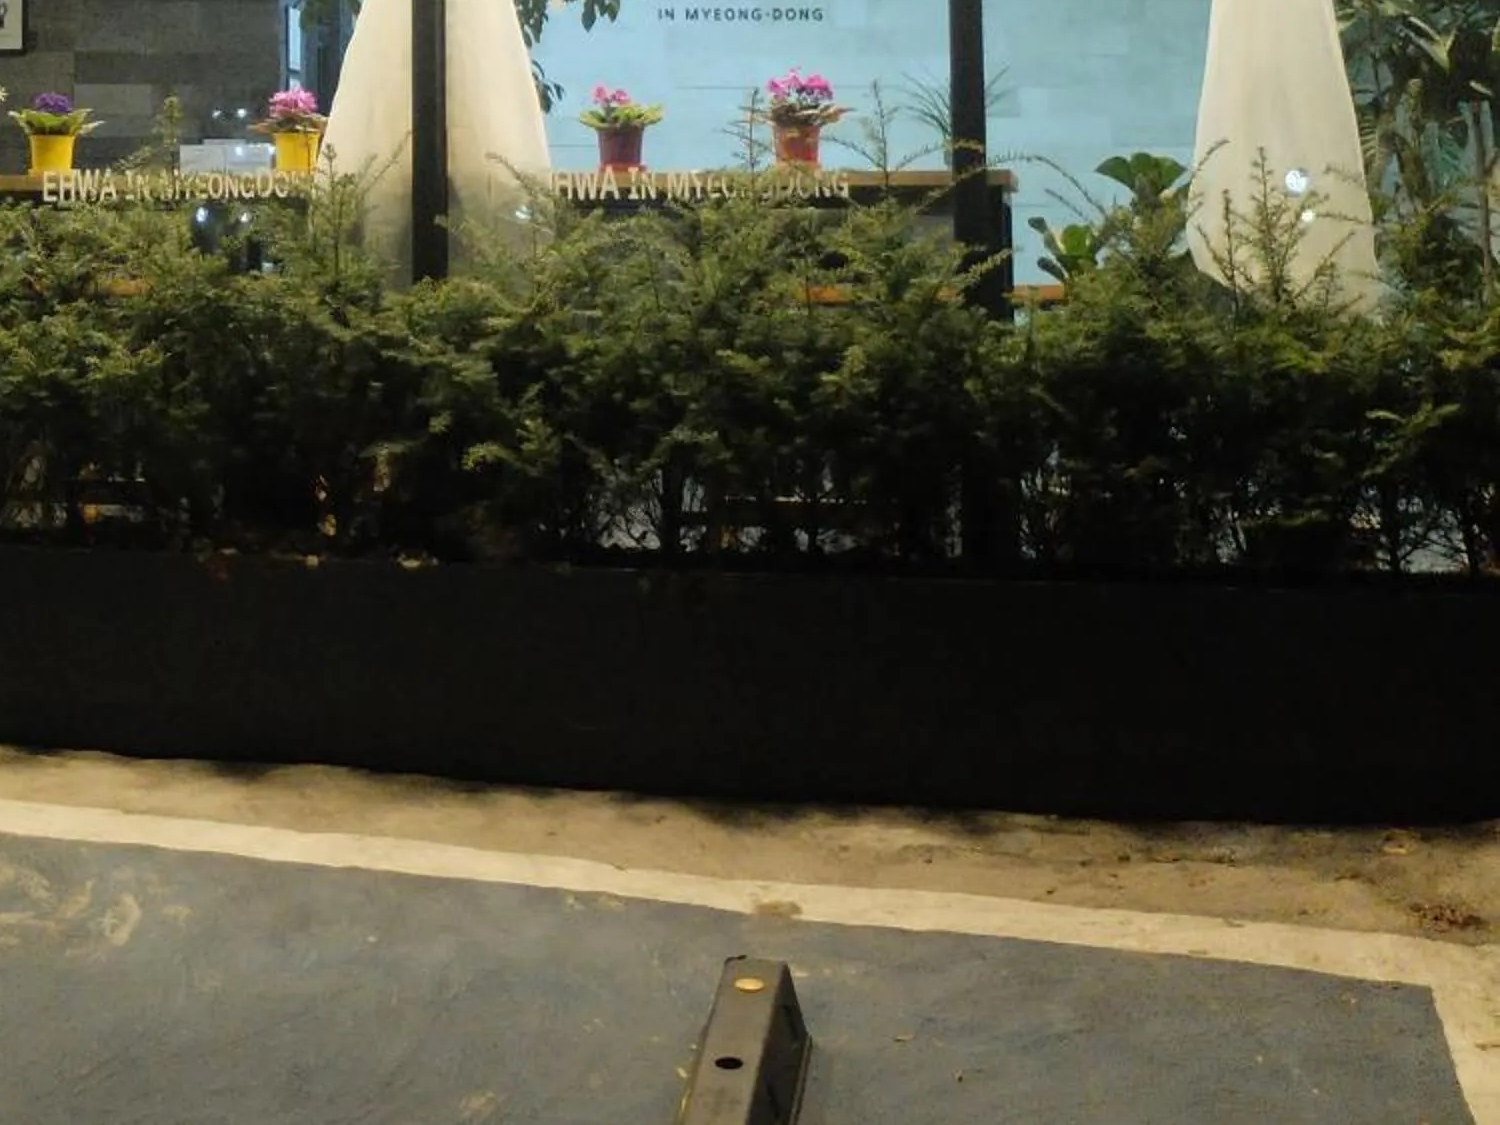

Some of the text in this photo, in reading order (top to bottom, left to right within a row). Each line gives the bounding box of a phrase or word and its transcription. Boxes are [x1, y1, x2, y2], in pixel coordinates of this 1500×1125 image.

[658, 7, 825, 22] IN MYEONG-DONG
[41, 167, 117, 203] EHWA
[548, 165, 621, 201] HWA
[627, 166, 657, 200] IN
